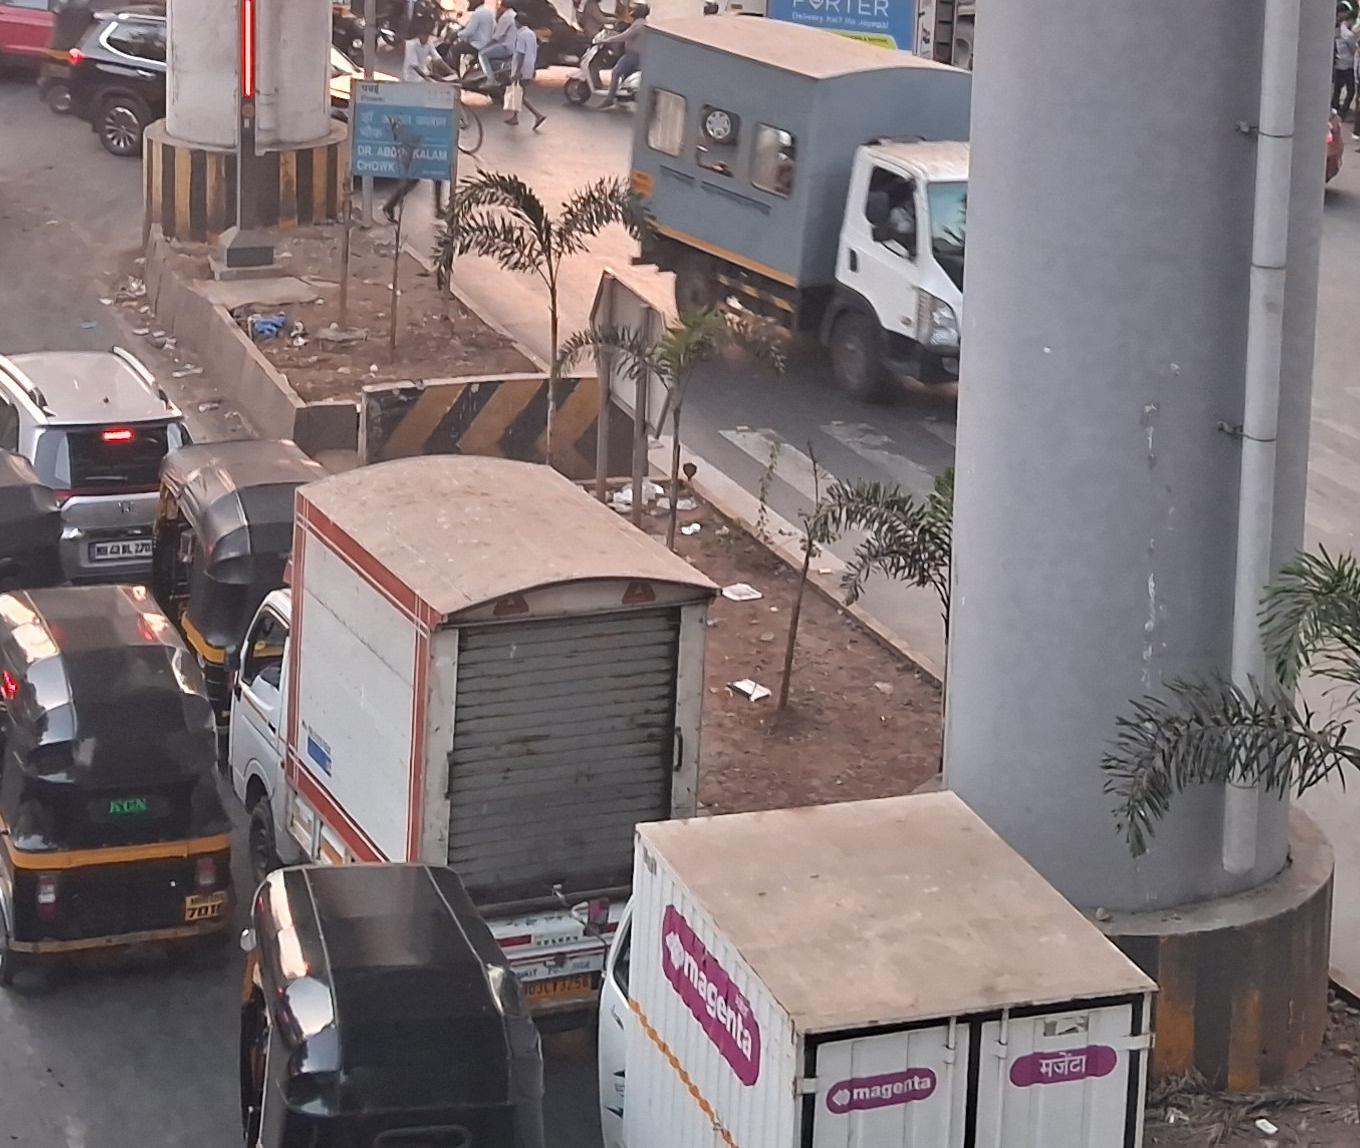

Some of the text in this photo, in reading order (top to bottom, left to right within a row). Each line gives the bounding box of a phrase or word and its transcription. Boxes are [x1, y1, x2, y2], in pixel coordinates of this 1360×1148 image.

[356, 159, 396, 172] CHOWK
[412, 148, 448, 161] KALAM
[683, 951, 753, 1062] magenta
[1039, 1052, 1087, 1078] मजेंटा
[853, 1074, 932, 1101] magenta
